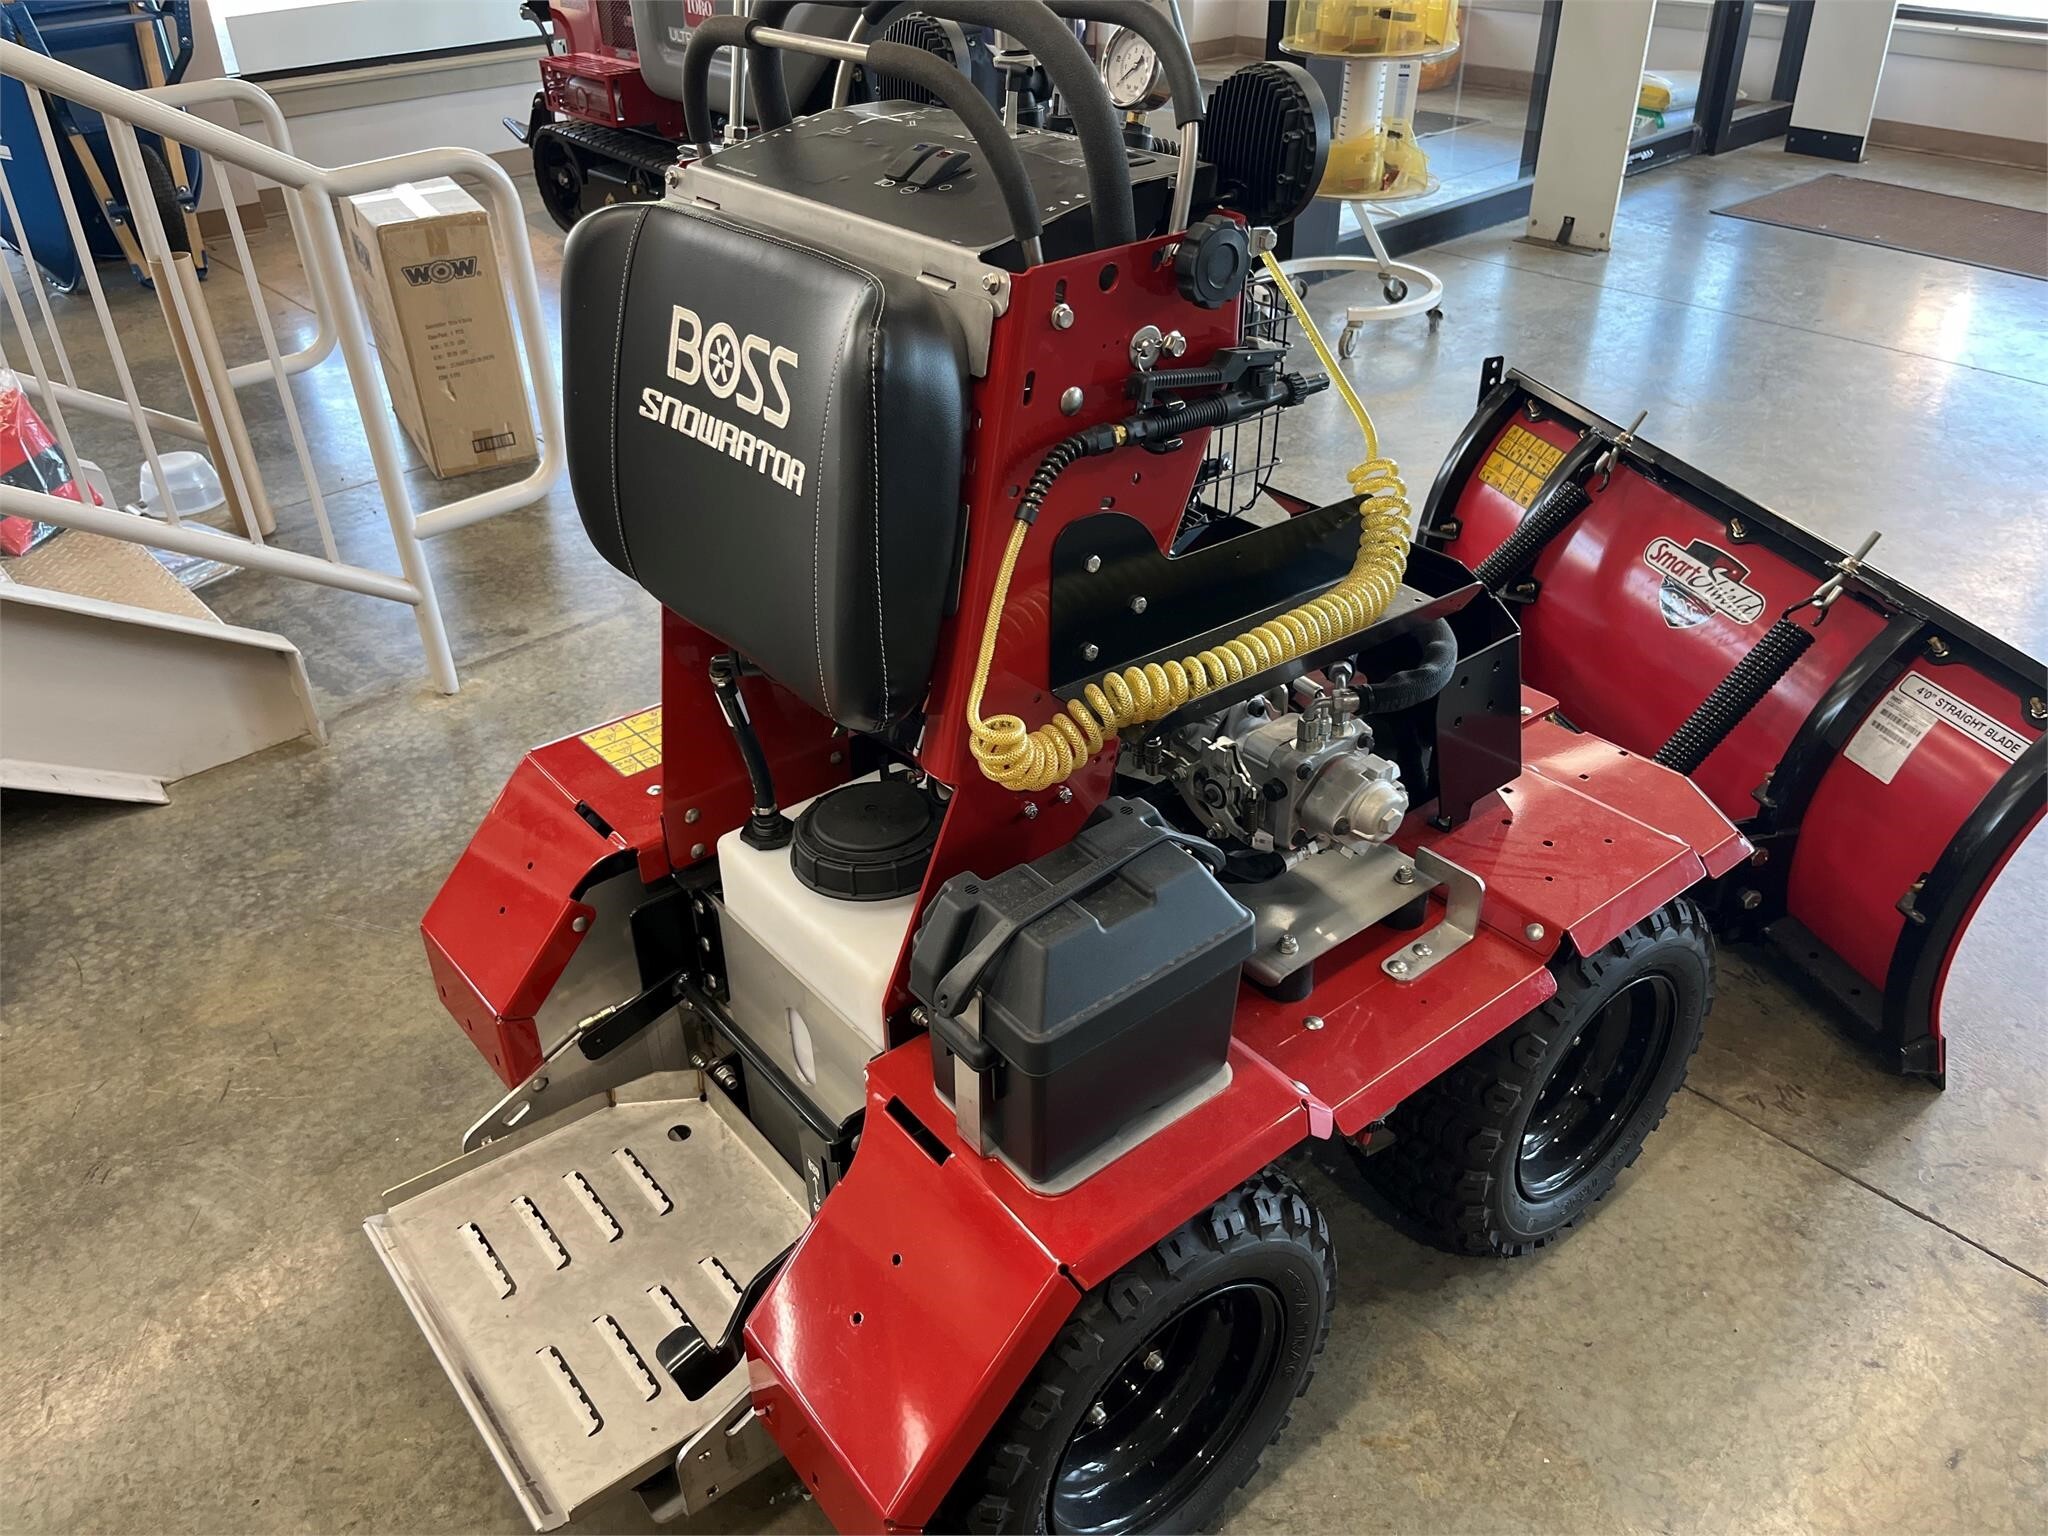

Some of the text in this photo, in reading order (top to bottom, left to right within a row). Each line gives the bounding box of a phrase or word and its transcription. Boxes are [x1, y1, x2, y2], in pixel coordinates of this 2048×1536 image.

[686, 0, 712, 17] TORO
[401, 256, 477, 286] WOW
[667, 304, 798, 429] BOSS
[639, 387, 806, 497] SNOWRATOR
[1649, 542, 1702, 580] Smart
[1934, 698, 1987, 732] STRAIGHT
[1985, 728, 2021, 754] BLADE
